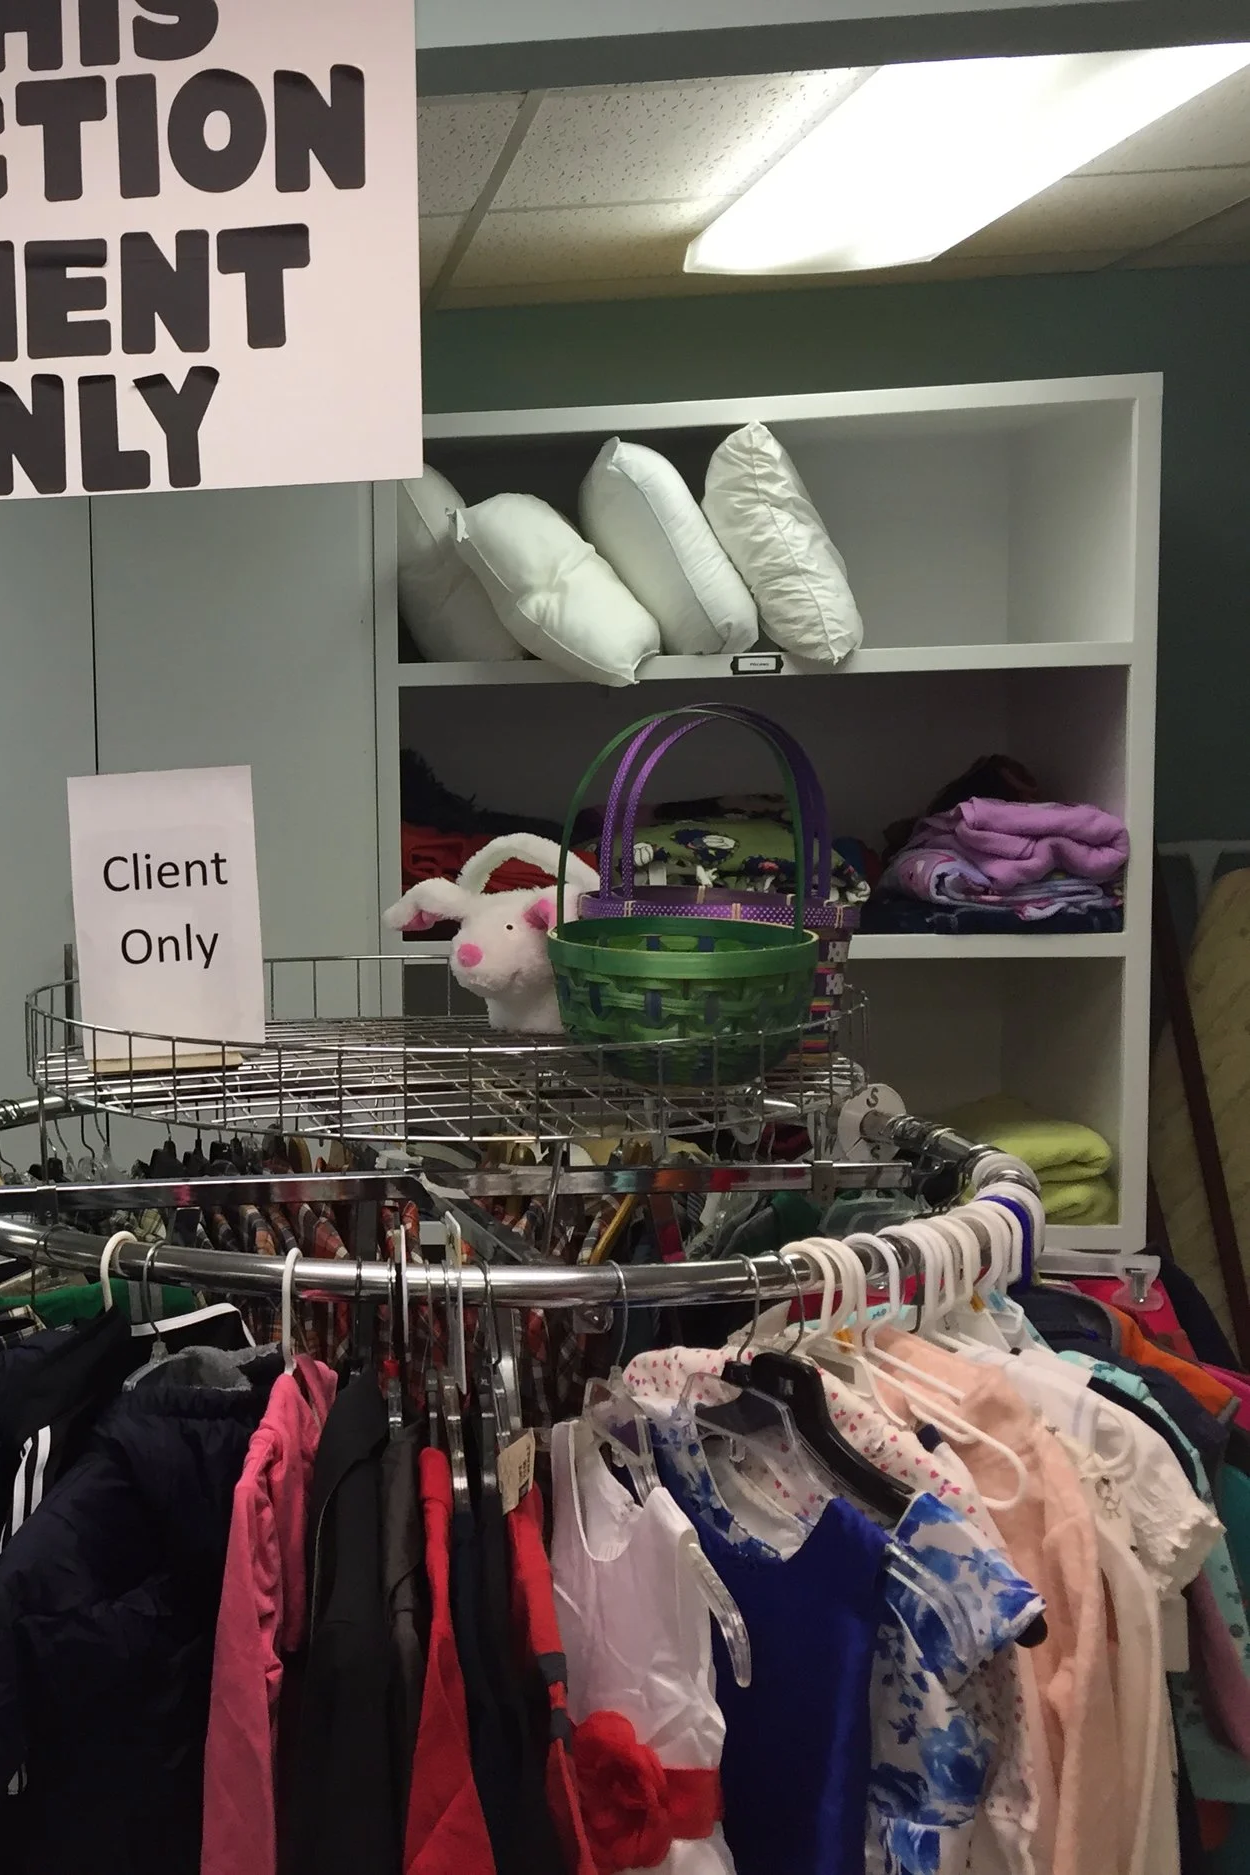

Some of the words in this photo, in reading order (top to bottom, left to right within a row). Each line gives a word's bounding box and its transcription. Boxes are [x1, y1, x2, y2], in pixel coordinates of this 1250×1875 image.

[103, 852, 228, 892] Client
[120, 923, 219, 969] Only
[866, 1087, 879, 1108] S
